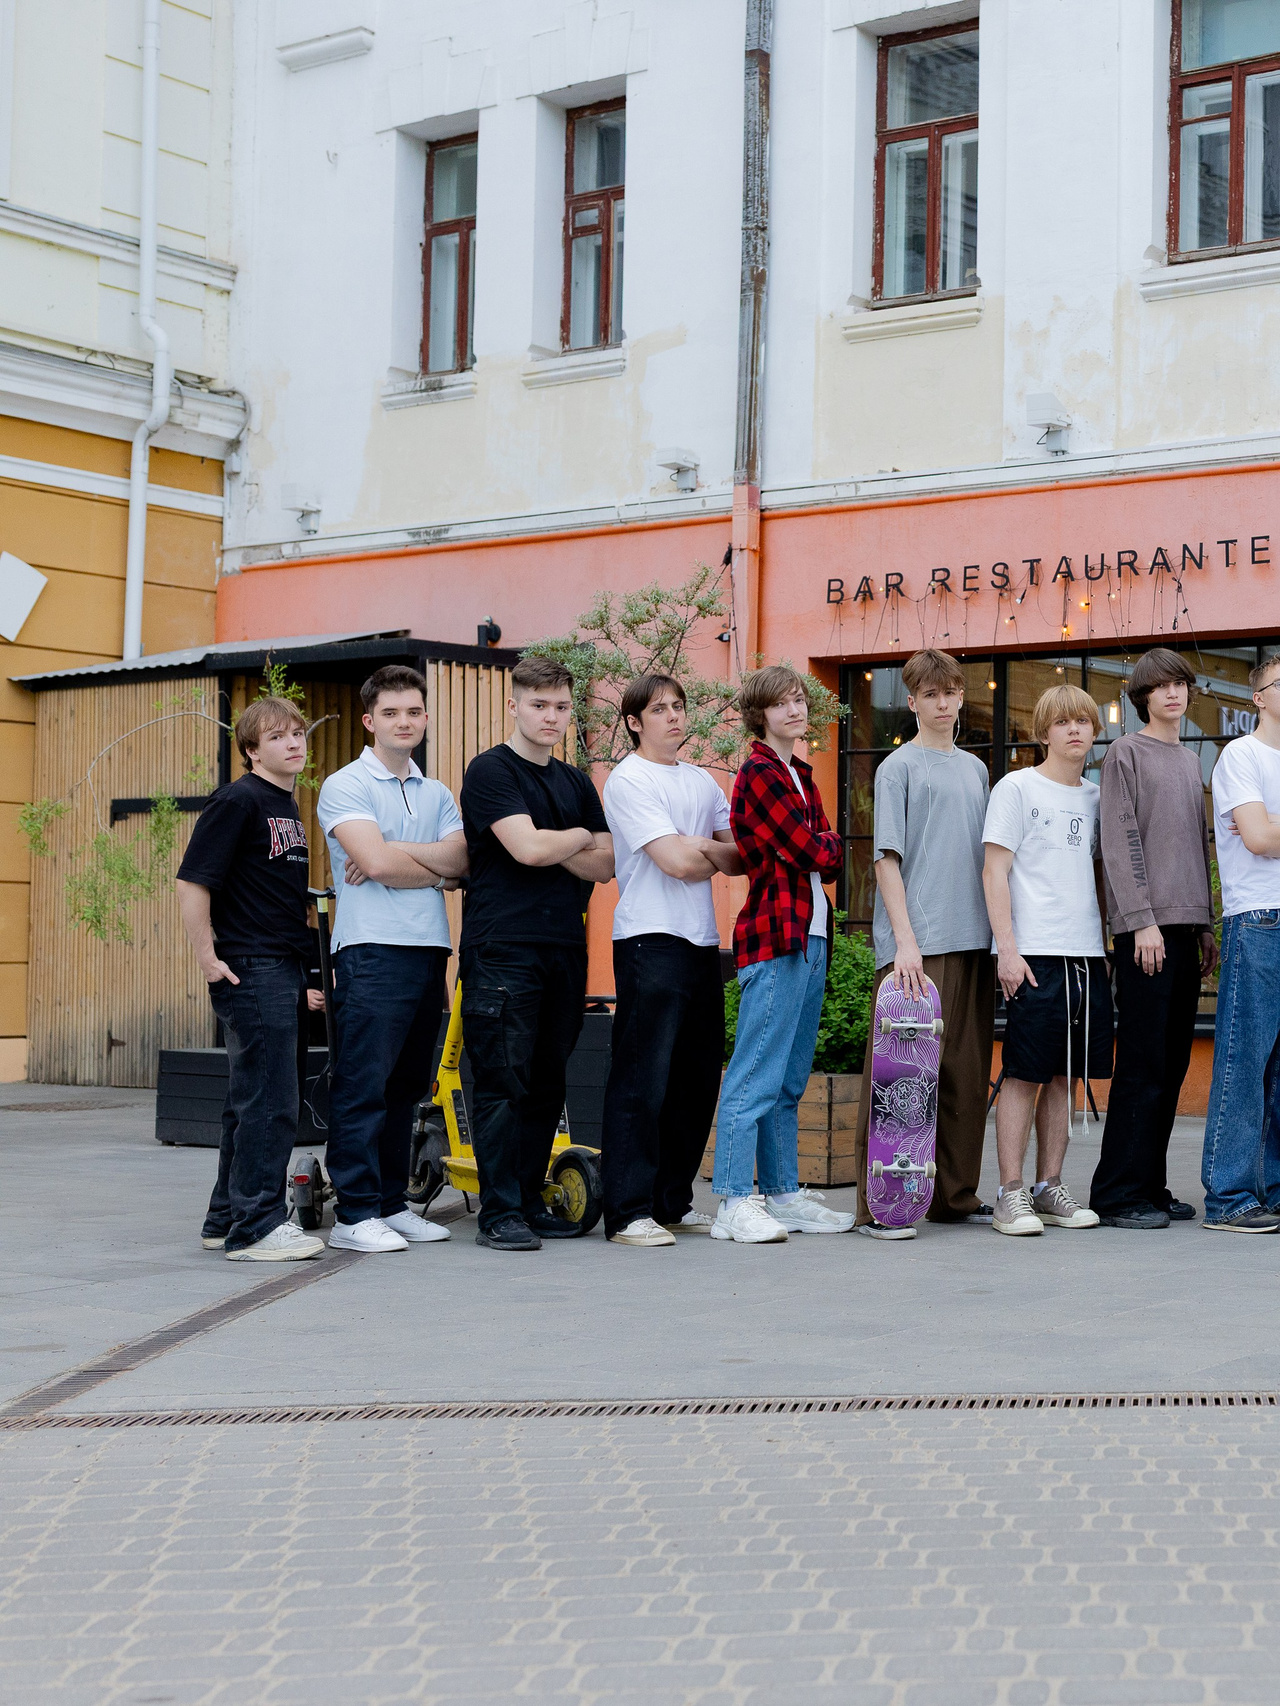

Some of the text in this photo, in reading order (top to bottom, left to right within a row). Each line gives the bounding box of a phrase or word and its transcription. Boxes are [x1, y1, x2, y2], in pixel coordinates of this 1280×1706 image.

[826, 535, 1271, 604] BAR RESTAURANTE
[1066, 834, 1082, 842] ZERO
[1126, 829, 1147, 889] YANDIAN
